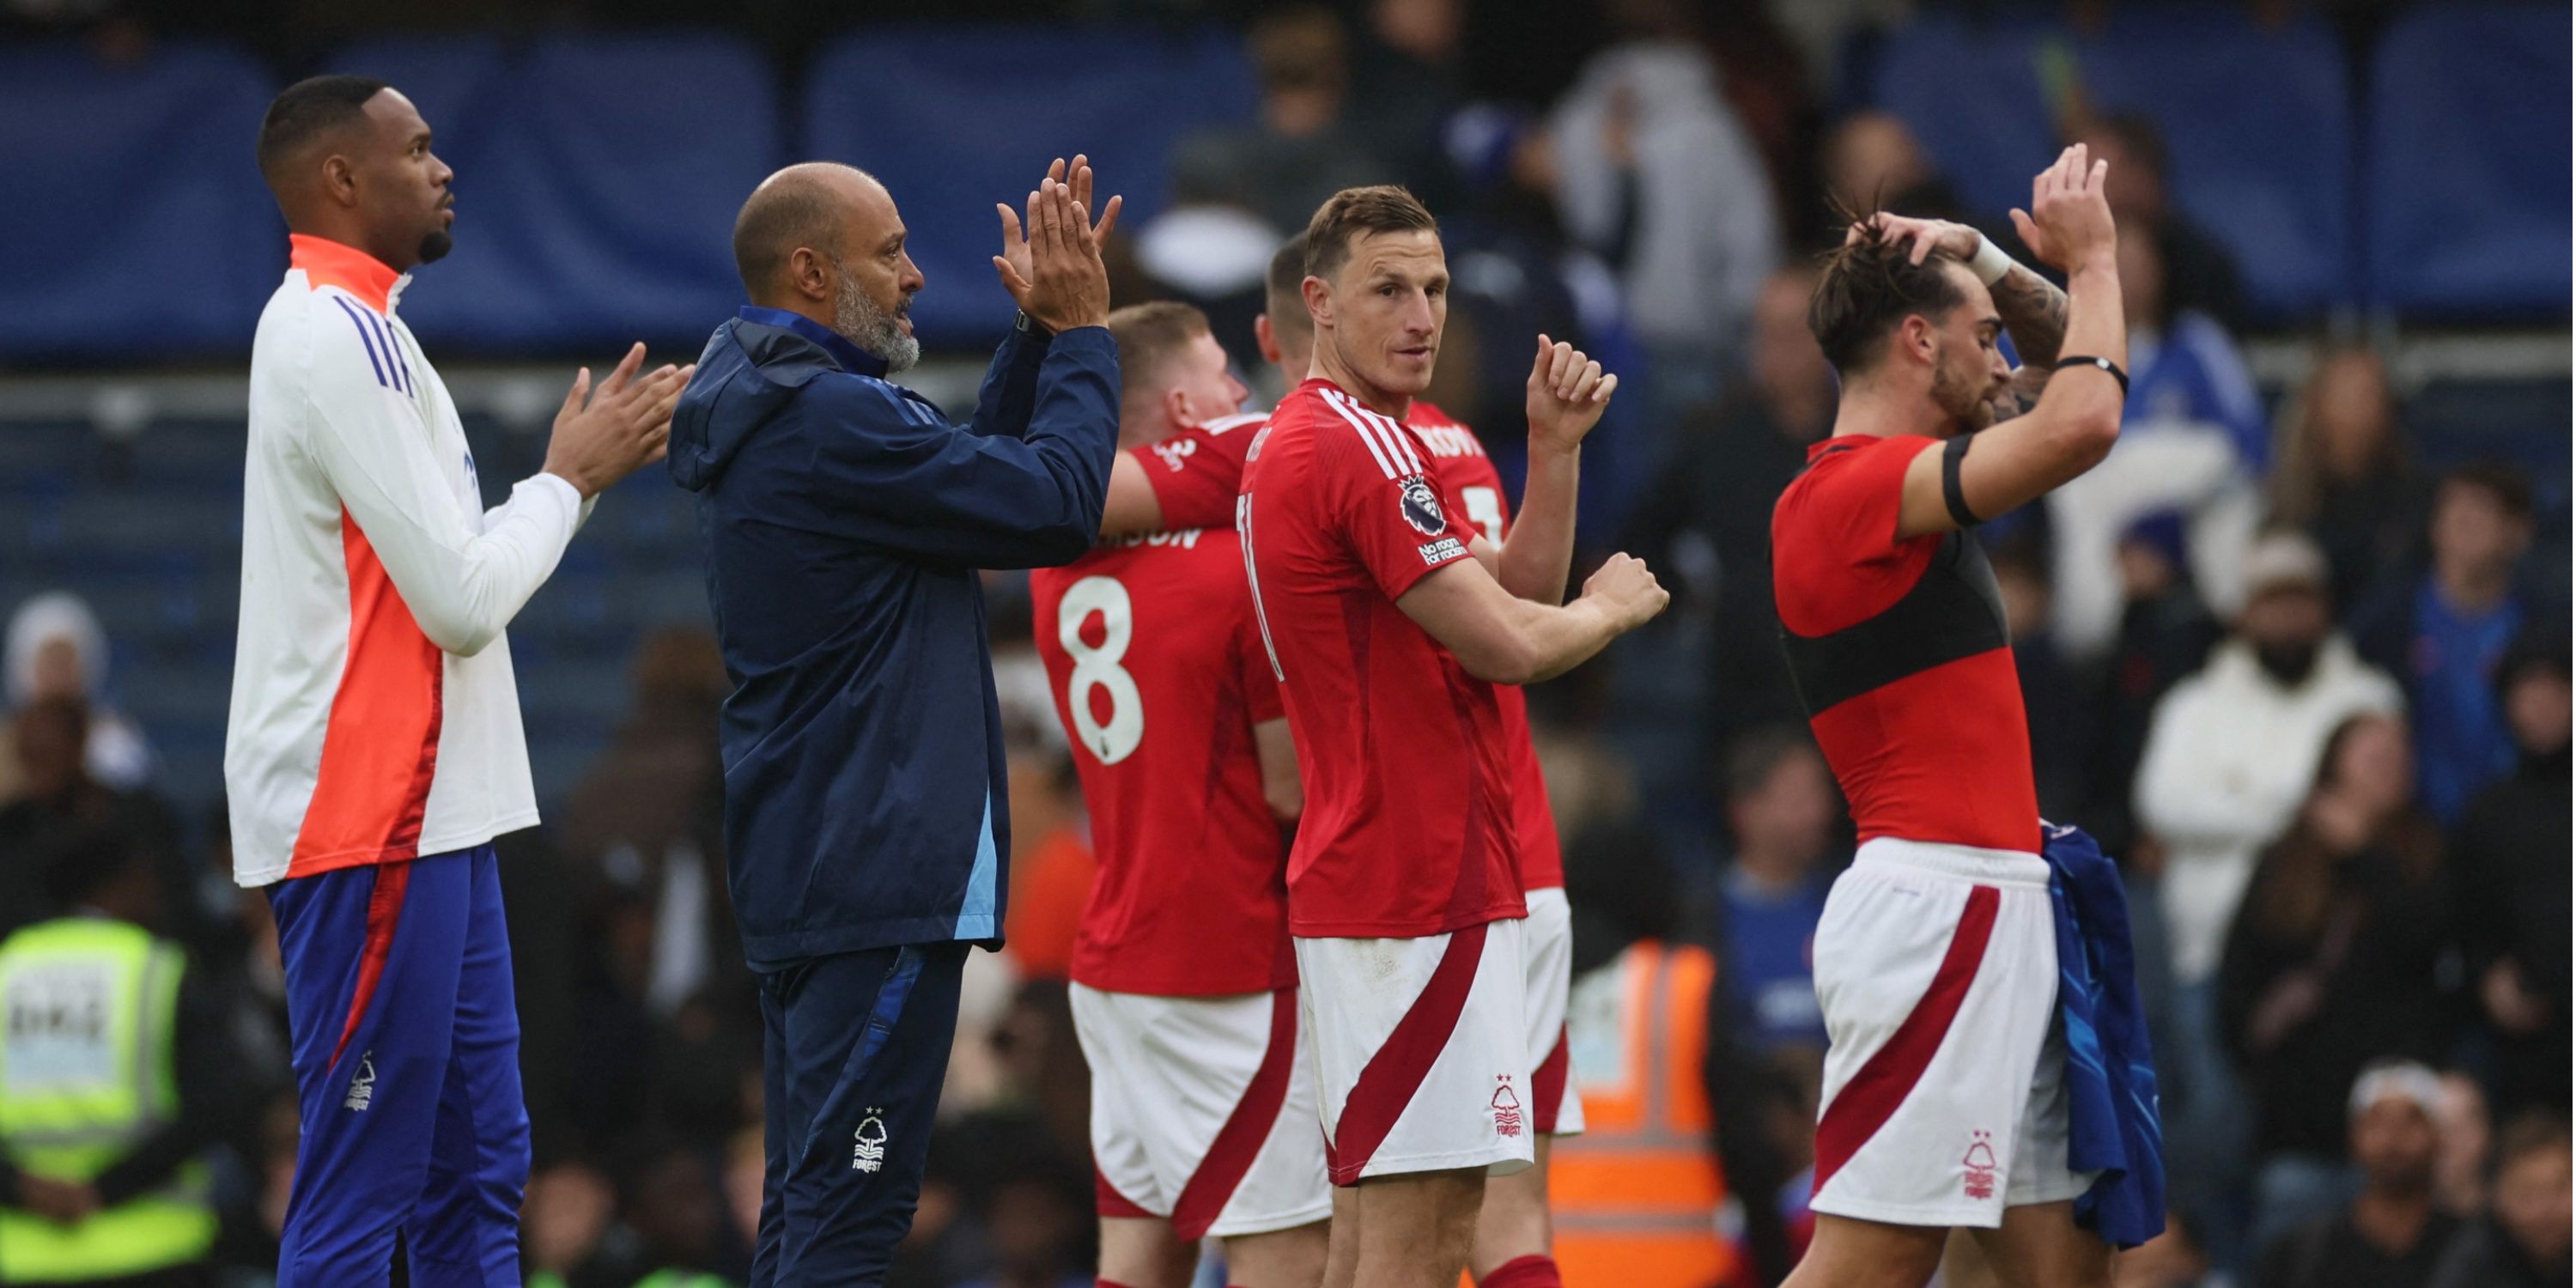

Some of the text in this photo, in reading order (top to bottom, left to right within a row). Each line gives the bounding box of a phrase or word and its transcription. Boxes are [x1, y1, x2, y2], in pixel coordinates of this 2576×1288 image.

[1418, 538, 1460, 556] No room
[1058, 574, 1145, 766] 8
